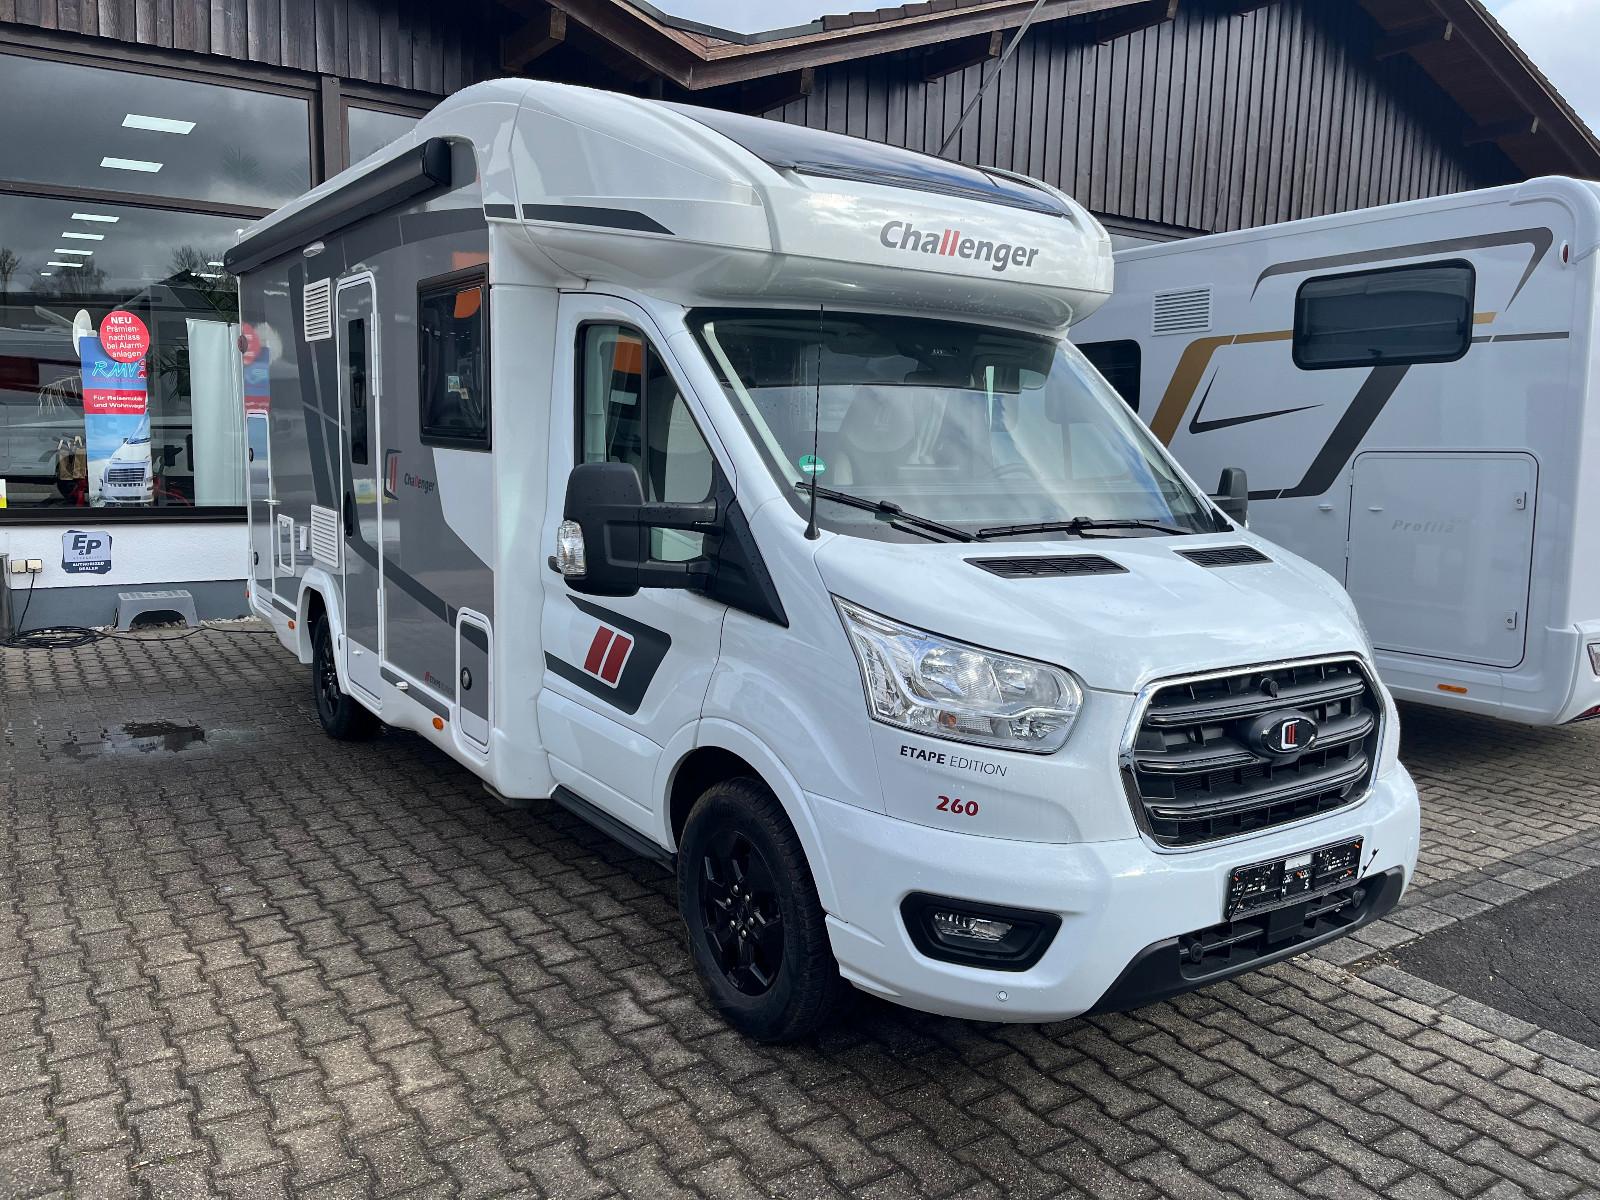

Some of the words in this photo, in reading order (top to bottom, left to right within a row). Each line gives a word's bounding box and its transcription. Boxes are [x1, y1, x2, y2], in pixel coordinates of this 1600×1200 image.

[880, 220, 1039, 272] Challenger
[112, 351, 142, 359] anlagen
[404, 472, 435, 494] Challenger
[900, 745, 947, 765] ETAPE
[949, 755, 1008, 777] EDITION
[936, 795, 979, 817] 260
